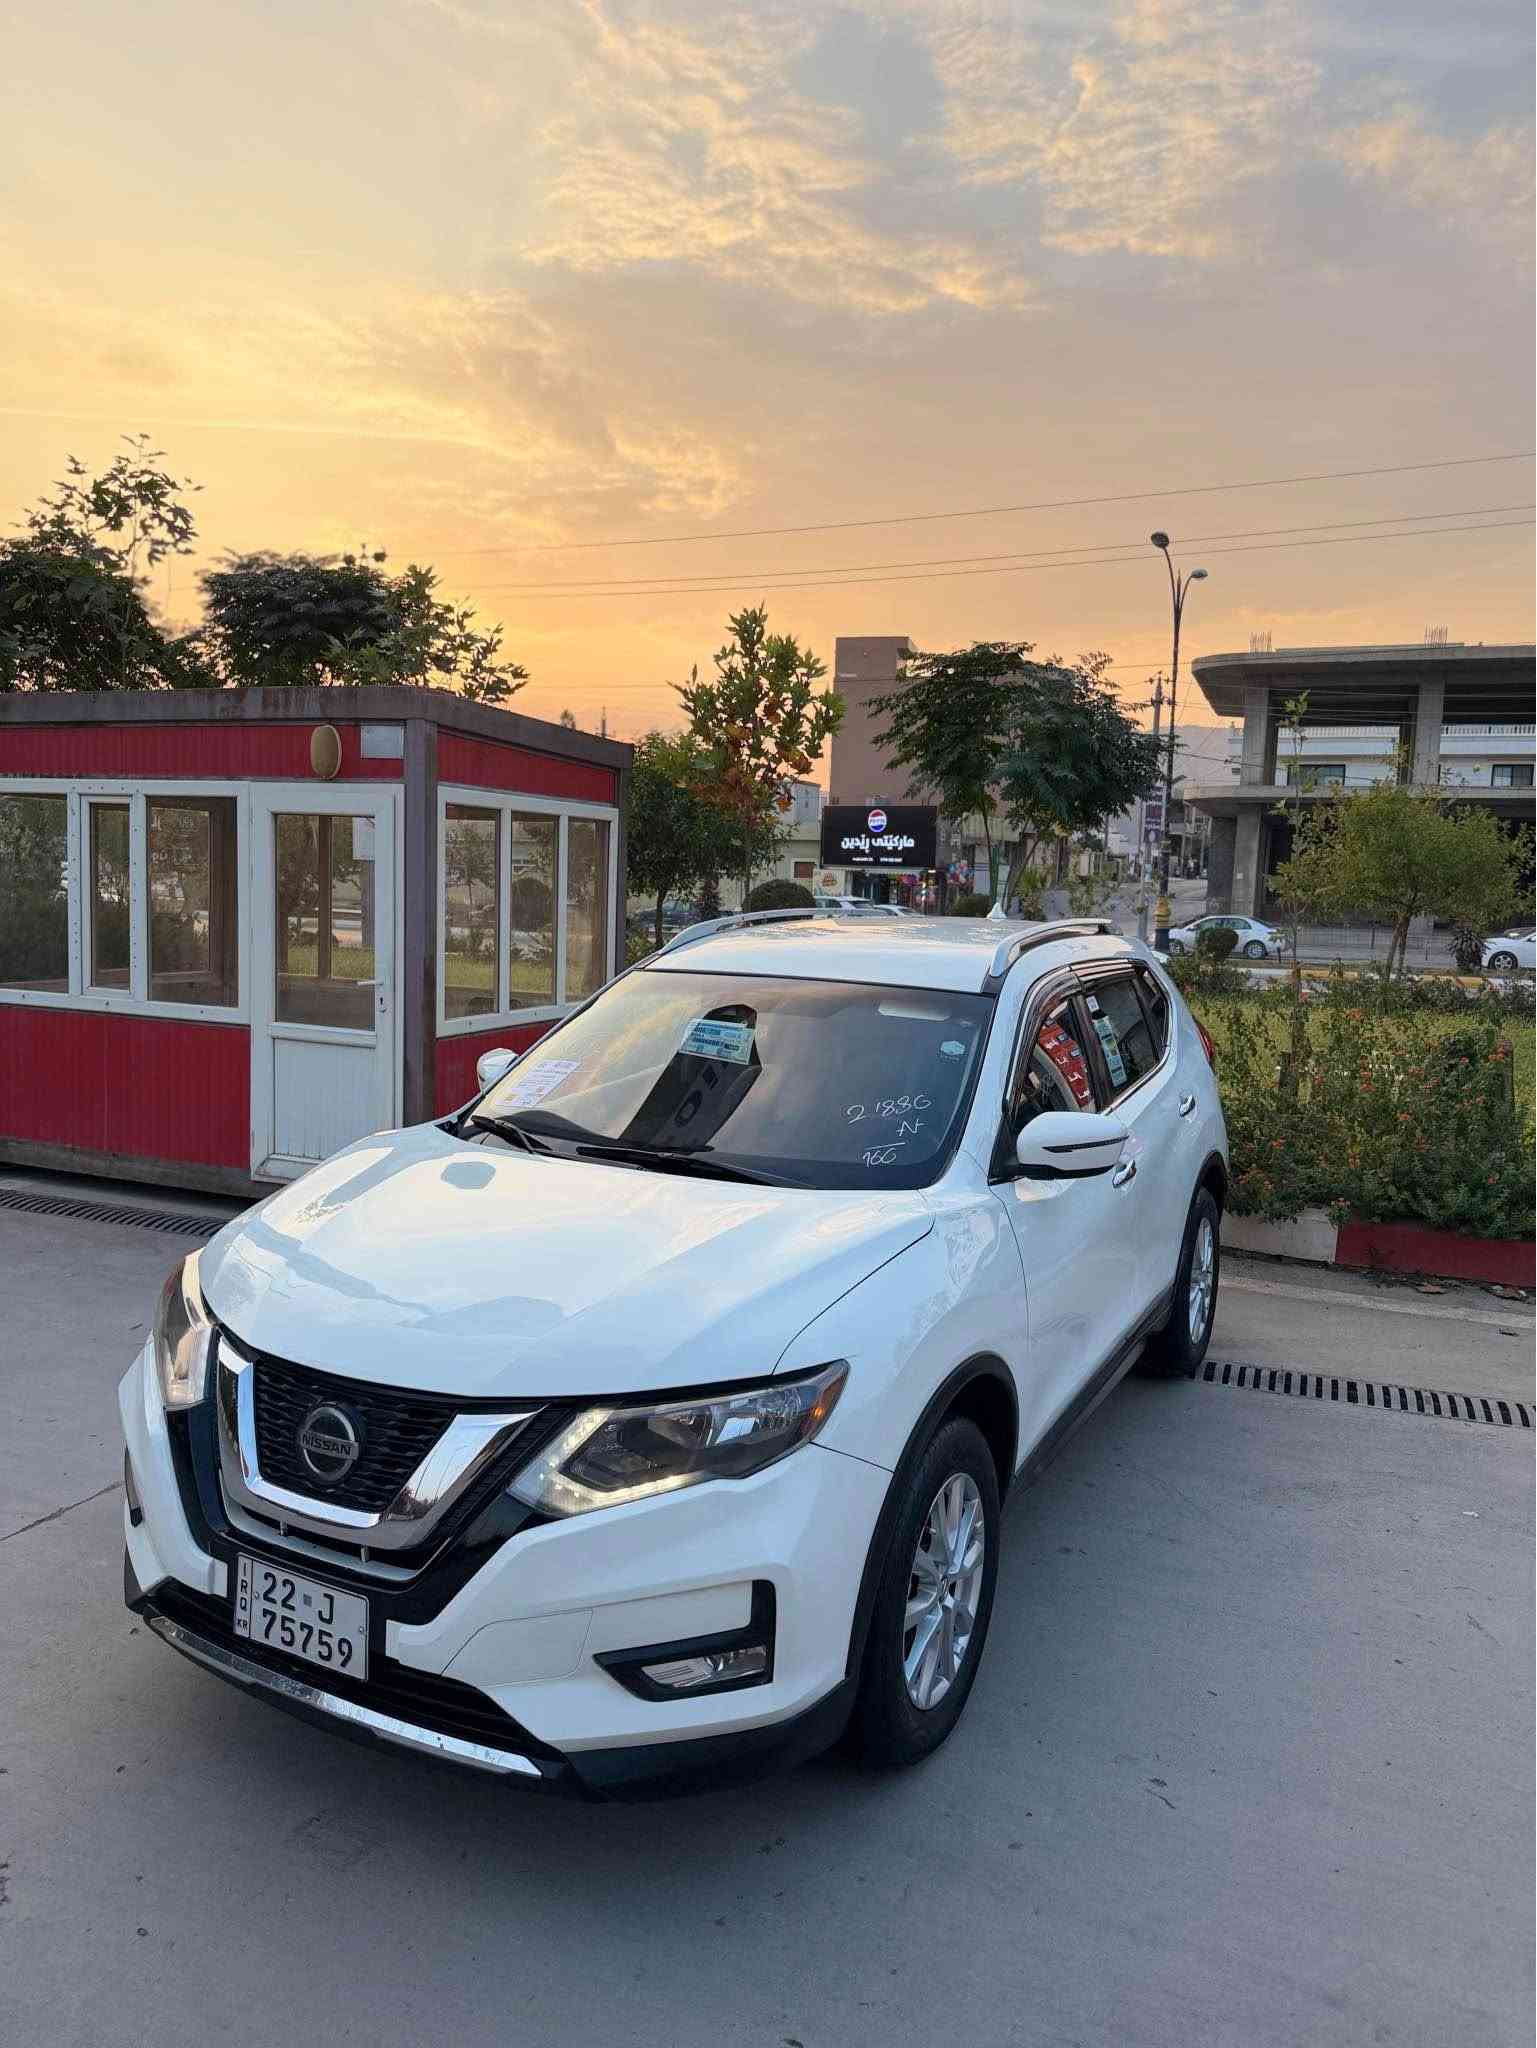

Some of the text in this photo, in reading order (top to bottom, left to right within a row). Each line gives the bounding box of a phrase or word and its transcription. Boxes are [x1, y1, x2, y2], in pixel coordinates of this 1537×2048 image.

[302, 1431, 352, 1457] NISSAN
[239, 1561, 249, 1612] IRQ
[262, 1571, 335, 1625] 22 J
[236, 1618, 249, 1631] KR
[262, 1607, 353, 1668] 75759
